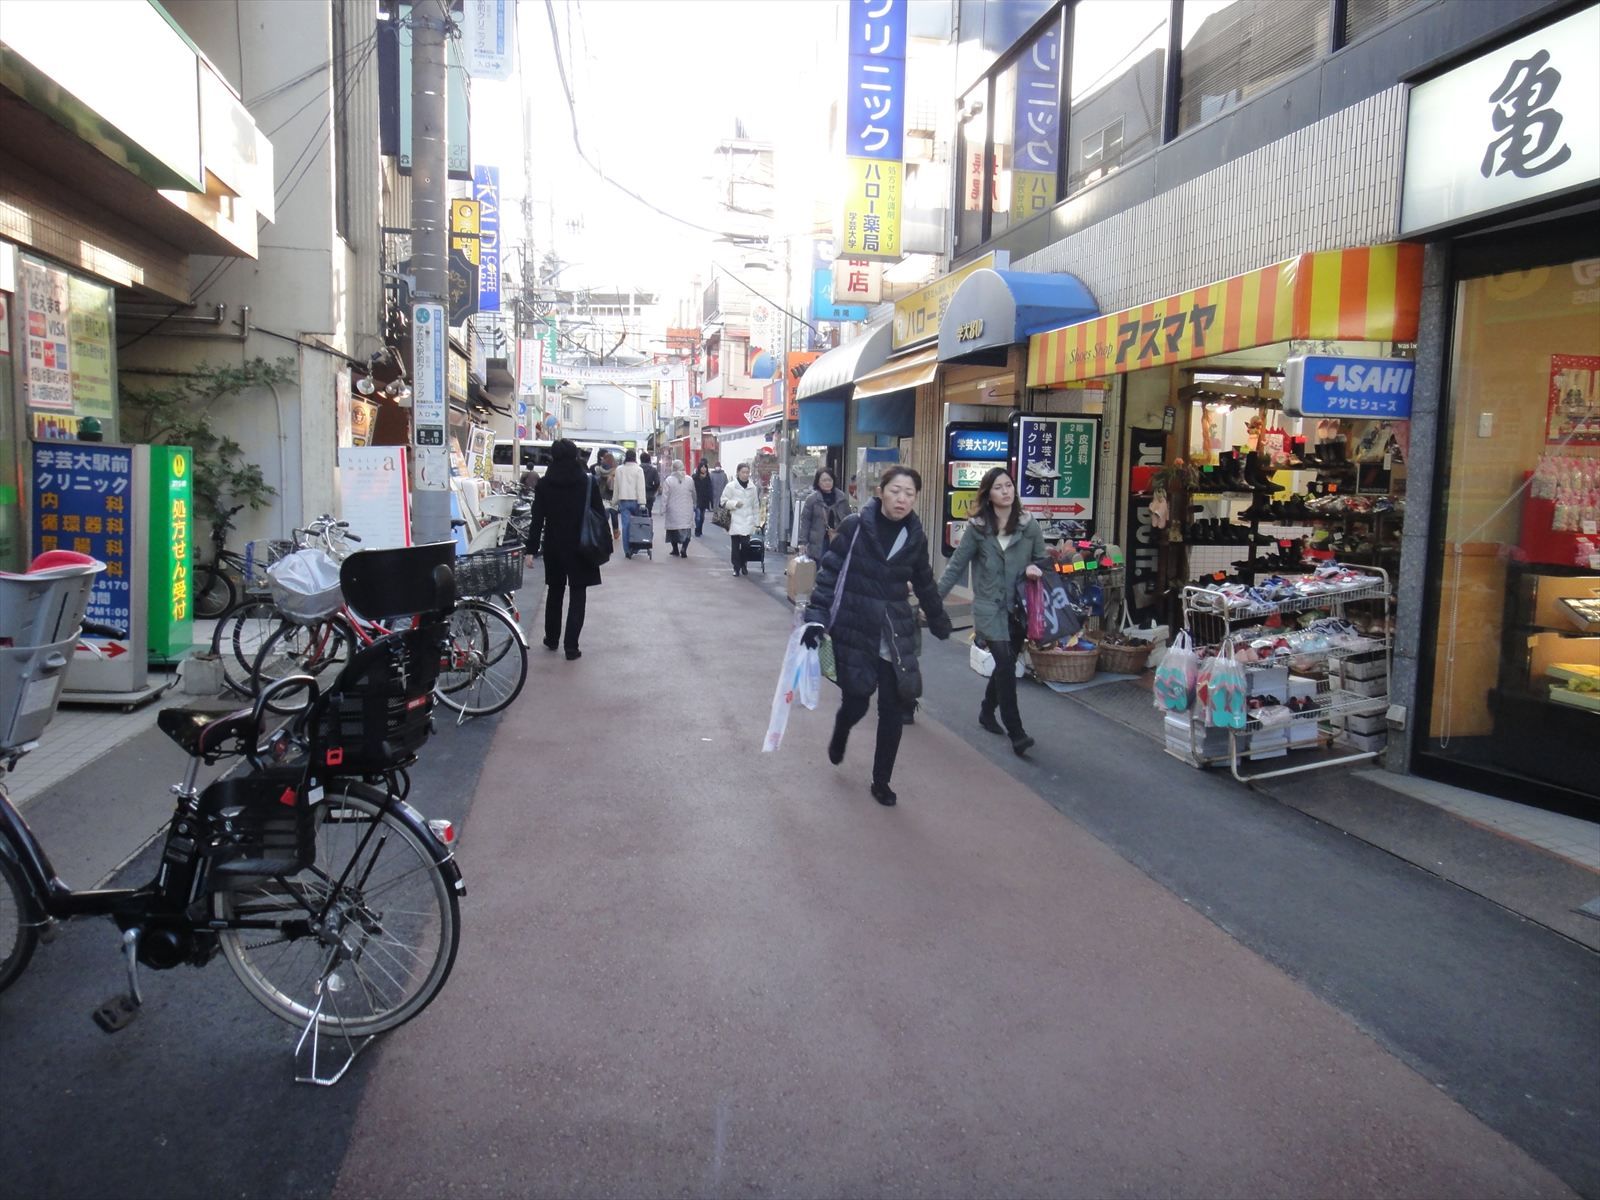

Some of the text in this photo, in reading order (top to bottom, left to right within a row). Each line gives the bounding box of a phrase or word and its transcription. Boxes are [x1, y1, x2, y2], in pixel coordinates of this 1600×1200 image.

[1481, 49, 1572, 179] 亀
[477, 184, 498, 253] KALDI
[863, 163, 881, 253] ハロー薬局
[848, 212, 857, 249] 学芸大学
[1115, 303, 1217, 365] アズマヤ
[1323, 364, 1413, 395] ASAHI
[1327, 396, 1397, 412] アサヒシューズ
[36, 450, 129, 473] 学芸大駅前
[1062, 433, 1075, 496] 呉クリニック
[1078, 433, 1089, 465] 皮膚科
[37, 472, 128, 495] クリニック
[41, 492, 124, 514] 内科
[41, 513, 124, 535] 循環器科
[171, 499, 187, 622] 処方せん受付
[86, 606, 128, 617] PM1:00
